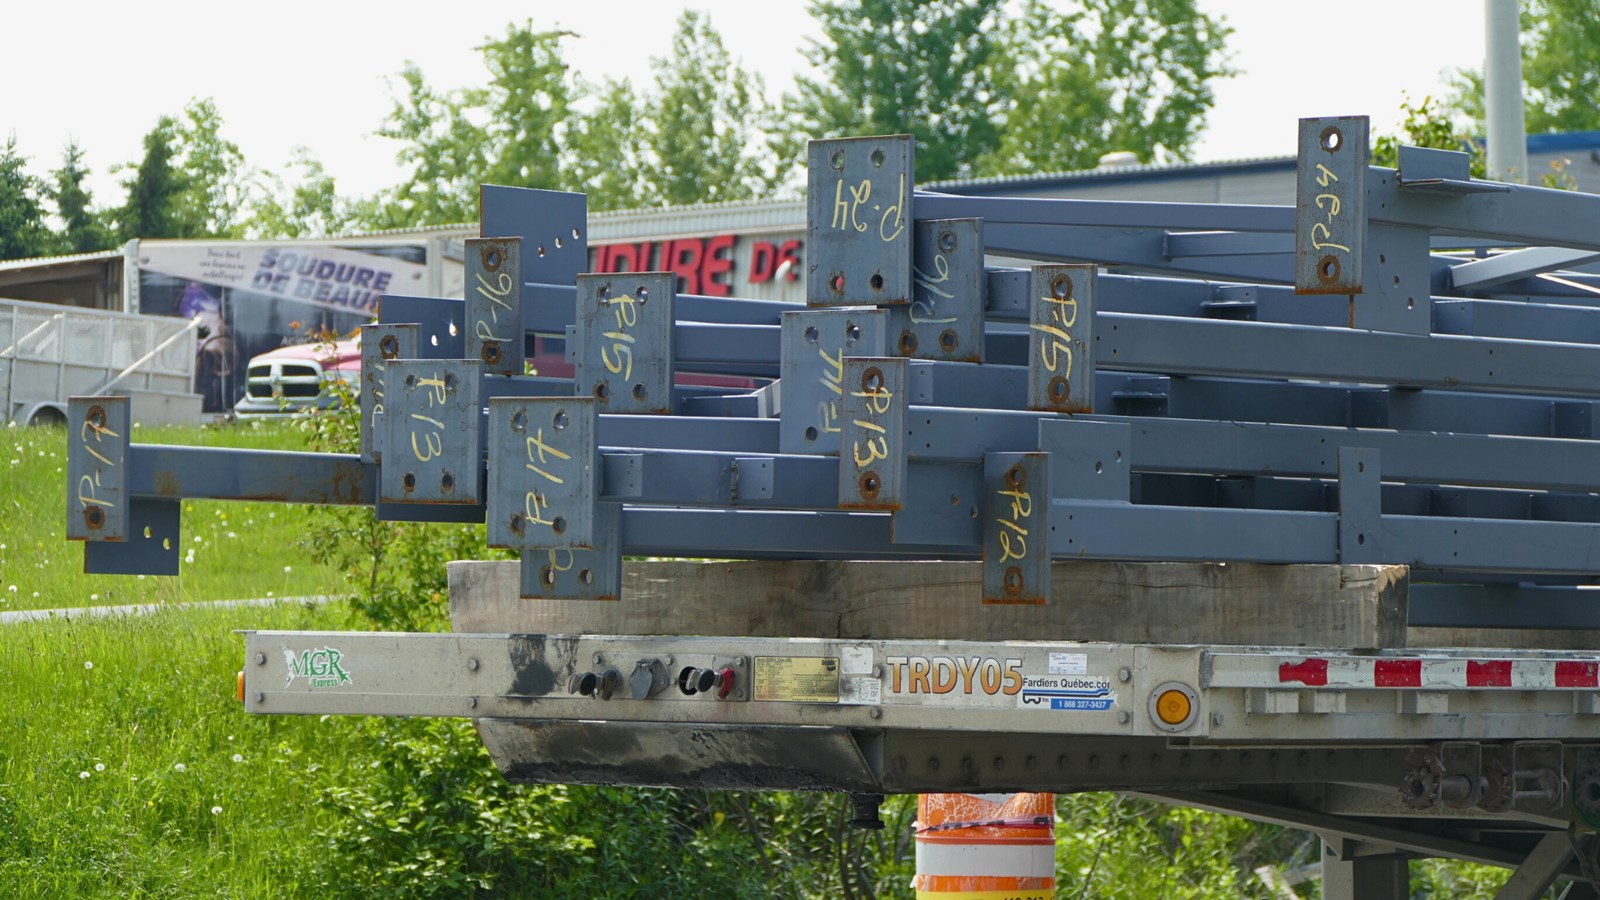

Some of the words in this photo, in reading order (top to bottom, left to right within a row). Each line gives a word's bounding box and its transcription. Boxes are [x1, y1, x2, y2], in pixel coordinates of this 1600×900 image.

[251, 268, 291, 294] DE
[259, 248, 393, 292] SOUDURE
[748, 239, 801, 284] DE
[475, 272, 513, 342] P-16
[602, 294, 637, 382] P-15
[1030, 296, 1077, 380] P-15
[411, 372, 447, 462] P-13
[851, 386, 893, 467] P-13
[79, 420, 120, 508] P-17
[525, 427, 572, 525] P-17
[996, 489, 1032, 564] P-12
[283, 645, 352, 684] MGR
[313, 678, 338, 688] Express
[886, 656, 1023, 695] TRDY05
[1023, 678, 1058, 687] Fardiers
[1076, 700, 1107, 709] 327-3437
